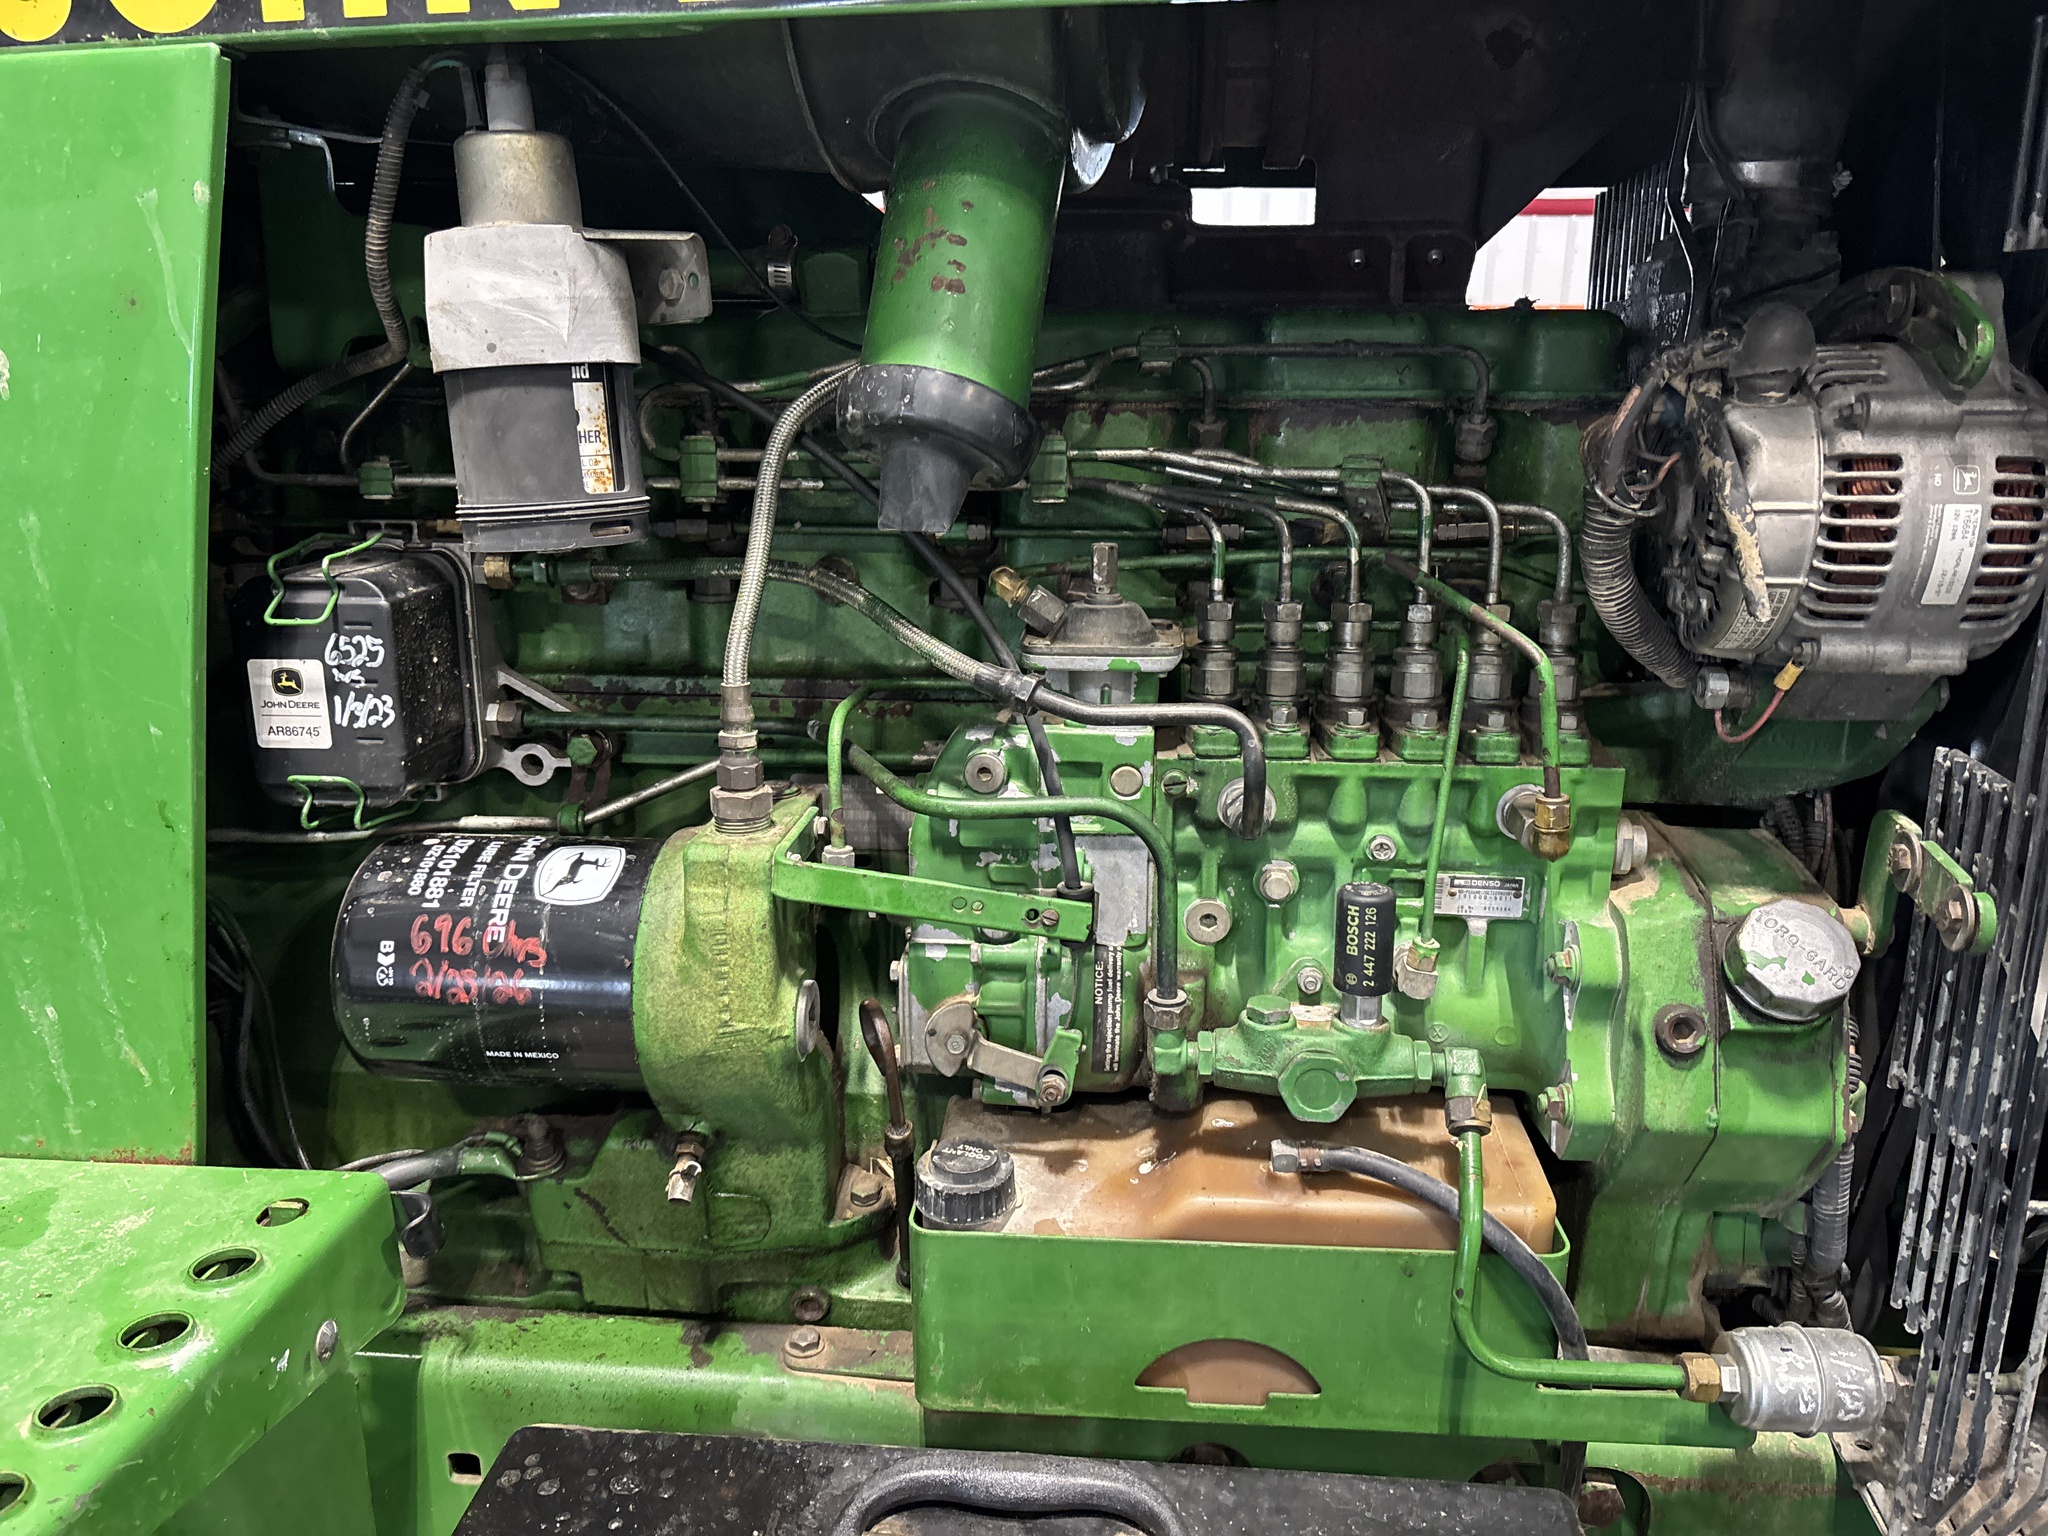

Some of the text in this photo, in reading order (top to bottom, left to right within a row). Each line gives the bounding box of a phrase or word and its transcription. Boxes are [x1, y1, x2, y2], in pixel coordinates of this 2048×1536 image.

[1968, 508, 1980, 548] ALTERNATOR
[324, 632, 385, 668] 6525
[260, 700, 321, 709] JOHN DEERE
[267, 725, 321, 737] AR86745
[407, 843, 447, 896] DZ101880
[421, 838, 476, 908] DZ101881
[459, 864, 488, 908] FILTER
[486, 863, 530, 943] DEERE
[1364, 907, 1377, 926] 126
[1346, 904, 1360, 956] BOSCH
[1363, 931, 1376, 951] 222
[1755, 909, 1847, 990] TORQ-GARD
[1107, 952, 1115, 978] delivery
[1115, 951, 1123, 981] warranty
[1363, 954, 1376, 977] 447
[1094, 960, 1104, 1005] NOTICE:
[1106, 978, 1114, 992] fuel
[1114, 982, 1122, 1003] Deere
[1105, 1015, 1114, 1043] injection
[485, 1050, 560, 1060] MADE IN MEXICO
[941, 1147, 991, 1160] COOLANT
[957, 1144, 983, 1154] ONLY
